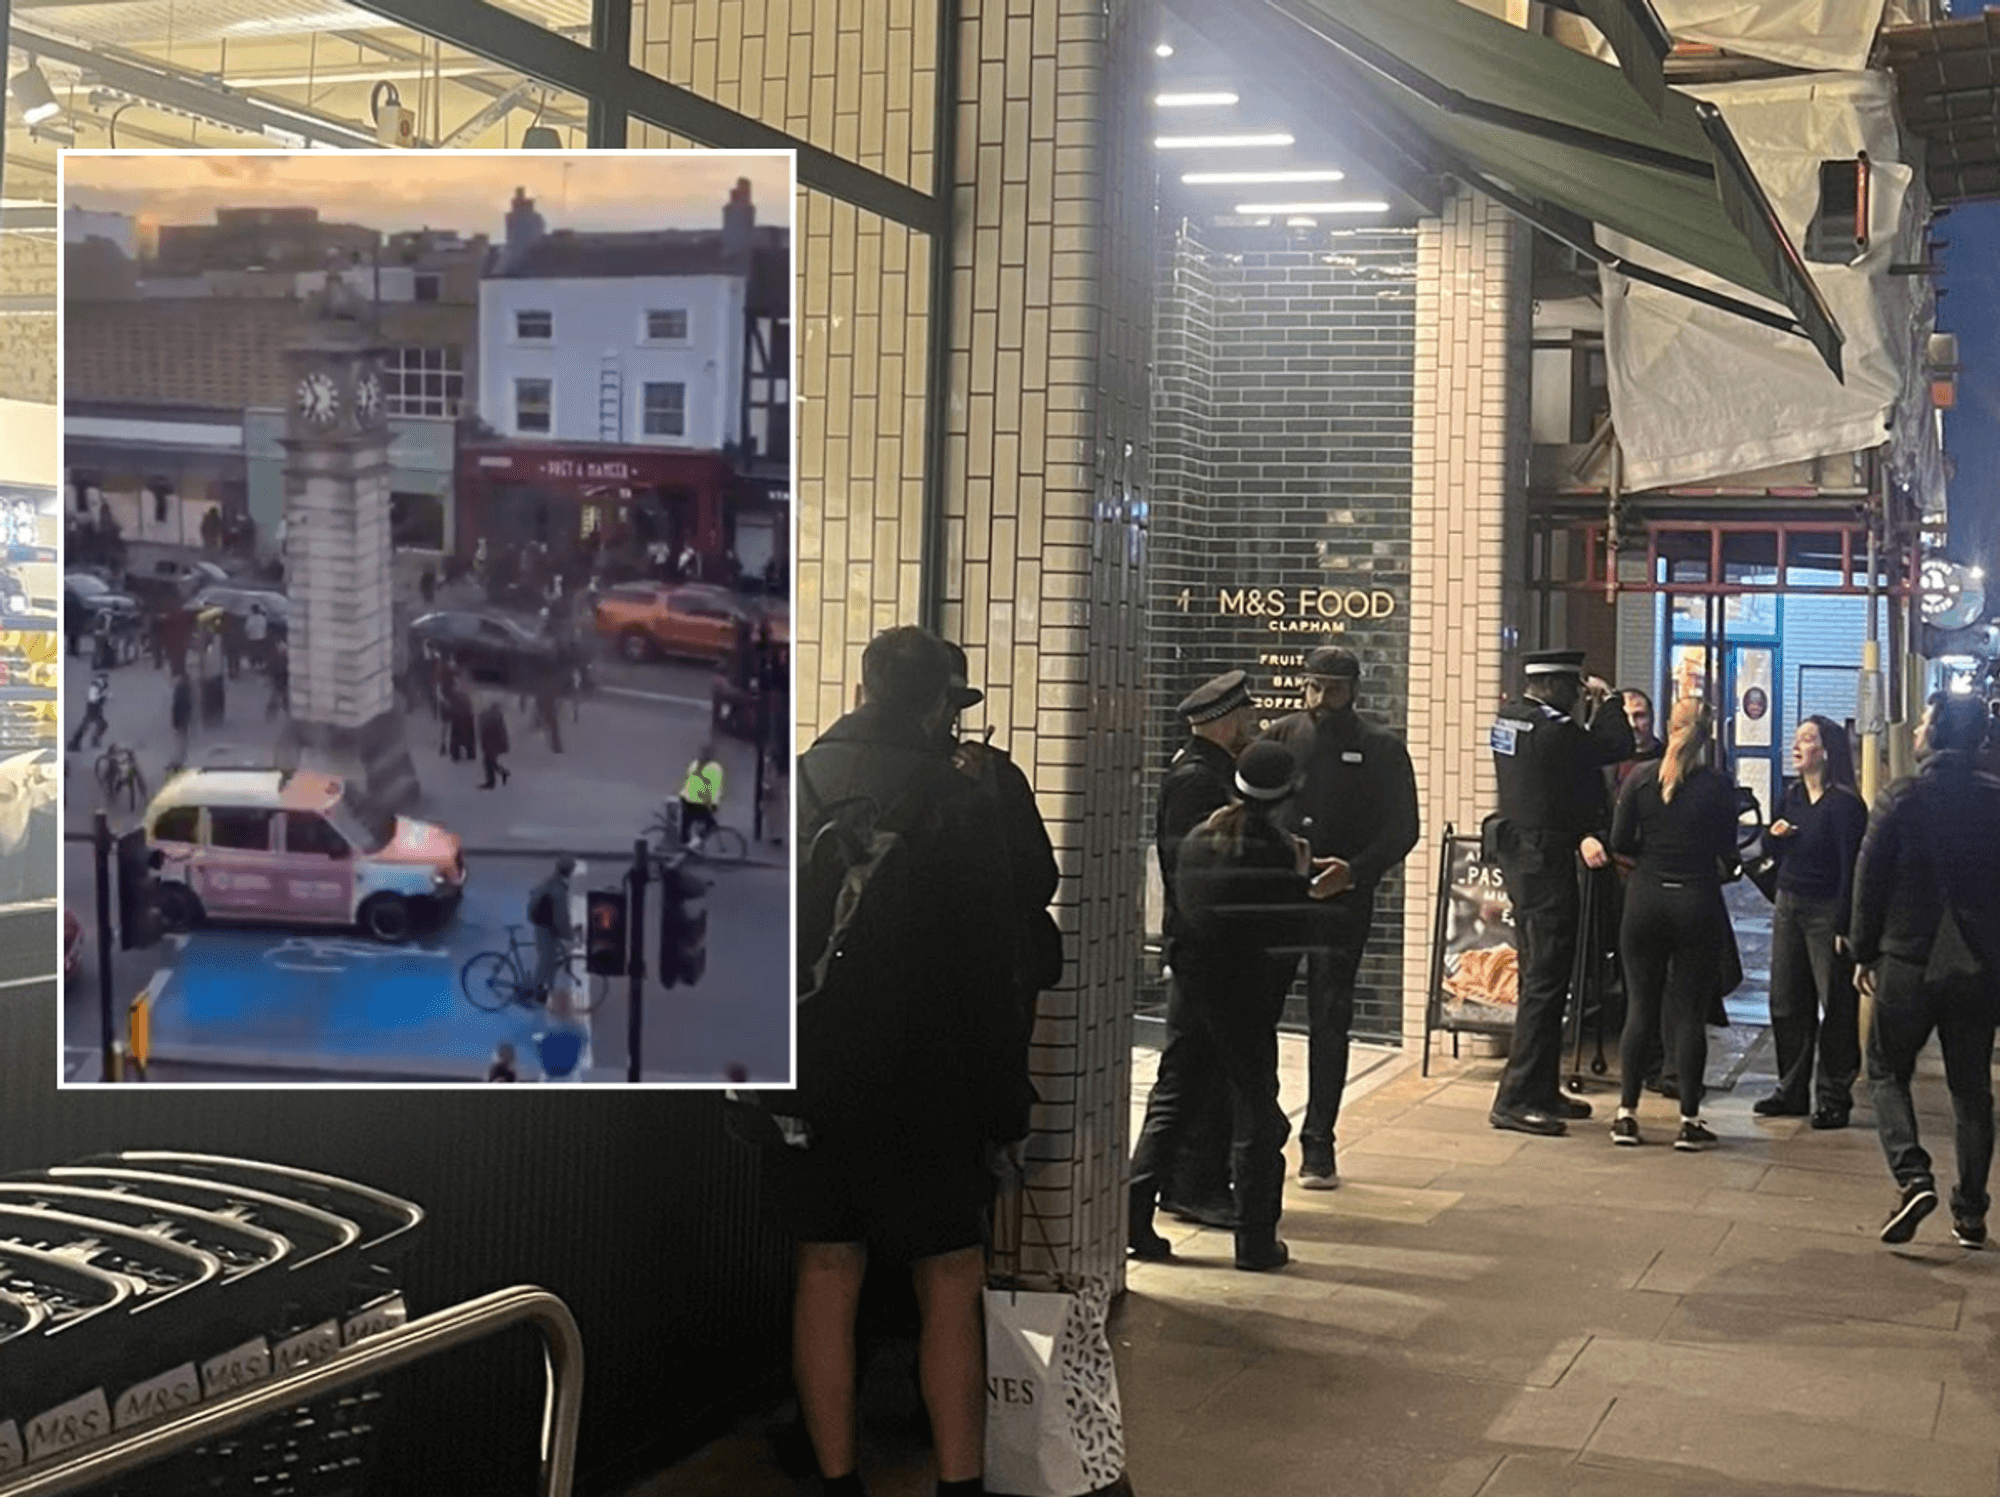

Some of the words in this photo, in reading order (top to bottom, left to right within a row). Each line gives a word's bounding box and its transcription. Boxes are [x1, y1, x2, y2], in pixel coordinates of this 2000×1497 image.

[1219, 588, 1286, 617] M&S
[1300, 590, 1395, 618] FOOD
[1268, 620, 1345, 632] CLAPHAM
[126, 1383, 192, 1420] M&S
[31, 1409, 100, 1450] M&S
